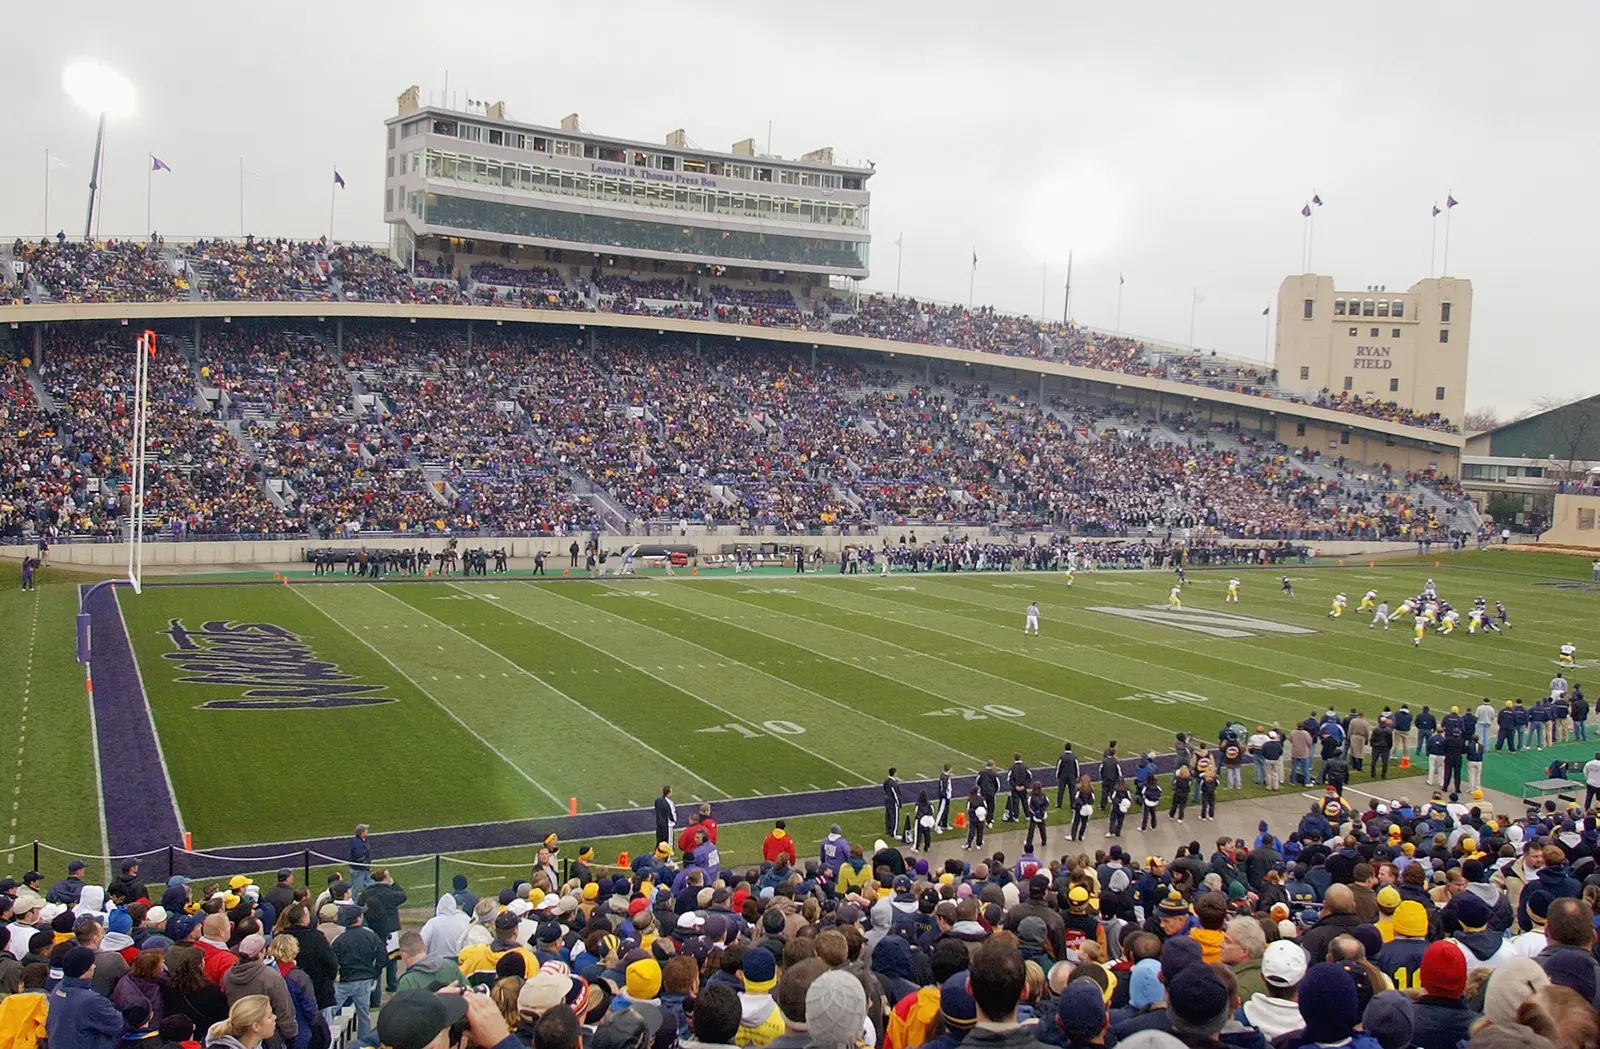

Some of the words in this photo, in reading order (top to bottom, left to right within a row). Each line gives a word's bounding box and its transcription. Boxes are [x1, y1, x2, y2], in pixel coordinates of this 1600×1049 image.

[590, 163, 626, 177] Leonard
[628, 168, 638, 178] B.
[640, 170, 673, 182] Thomas
[675, 174, 699, 185] Press
[701, 177, 717, 187] Box
[1356, 345, 1392, 357] RYAN
[1353, 358, 1392, 369] FIELD
[1134, 690, 1209, 704] 30
[942, 704, 1026, 721] 20
[724, 719, 806, 739] 10
